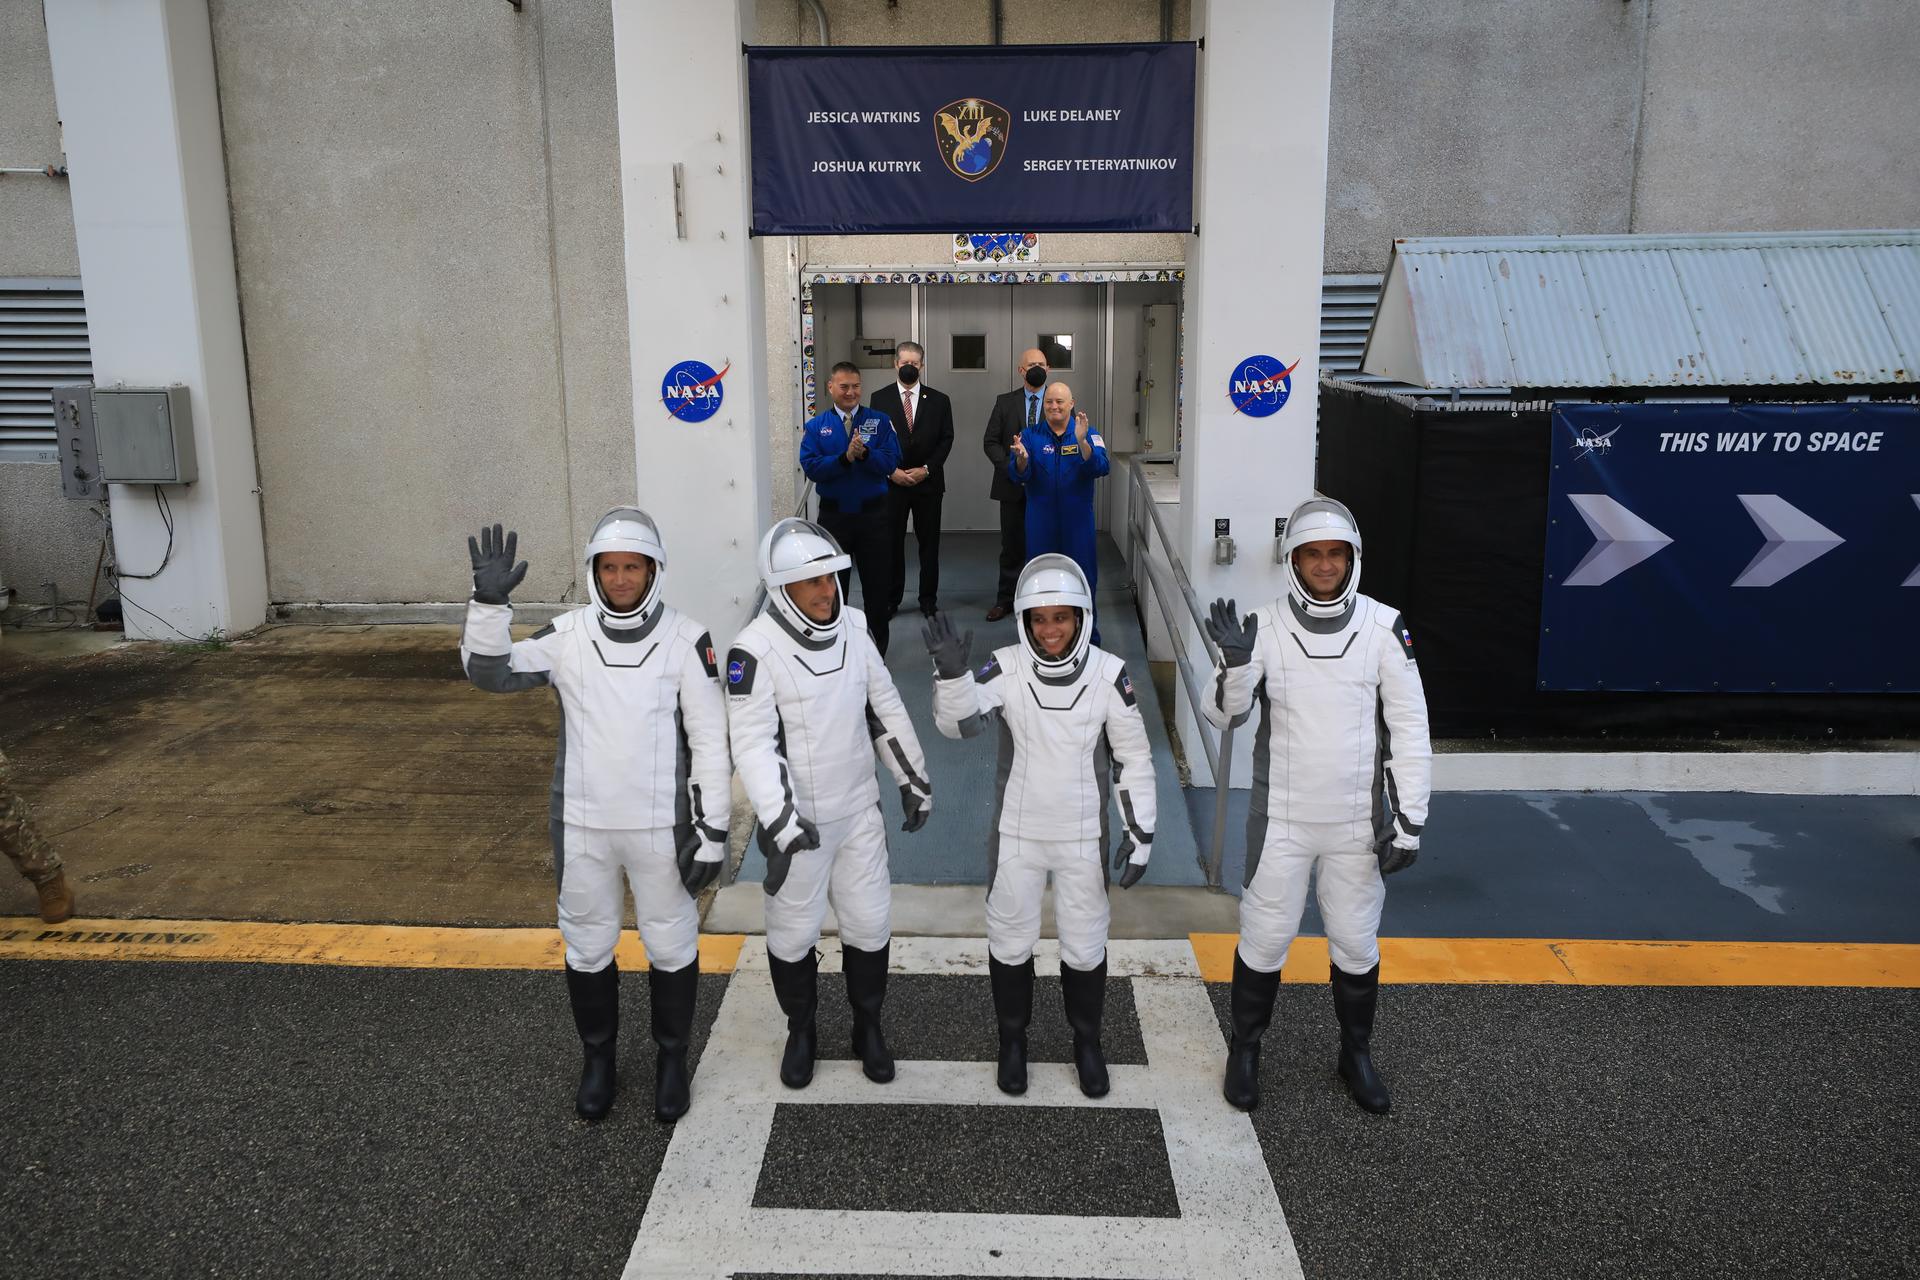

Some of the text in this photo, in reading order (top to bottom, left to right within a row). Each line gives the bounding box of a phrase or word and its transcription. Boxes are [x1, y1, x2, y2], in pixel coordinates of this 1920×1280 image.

[808, 112, 921, 123] JESSICA WATKINS
[958, 106, 985, 120] XIII
[1023, 110, 1121, 122] LUKE DELANEY
[812, 161, 922, 173] JOSHUA KUTRYK
[1023, 158, 1177, 172] SERGEY TETERYATNIKOV
[666, 385, 720, 398] NASA
[1234, 380, 1288, 393] NASA
[1575, 438, 1612, 447] NASA
[1659, 431, 1884, 452] THIS WAY TO SPACE
[32, 930, 218, 944] PARKING
